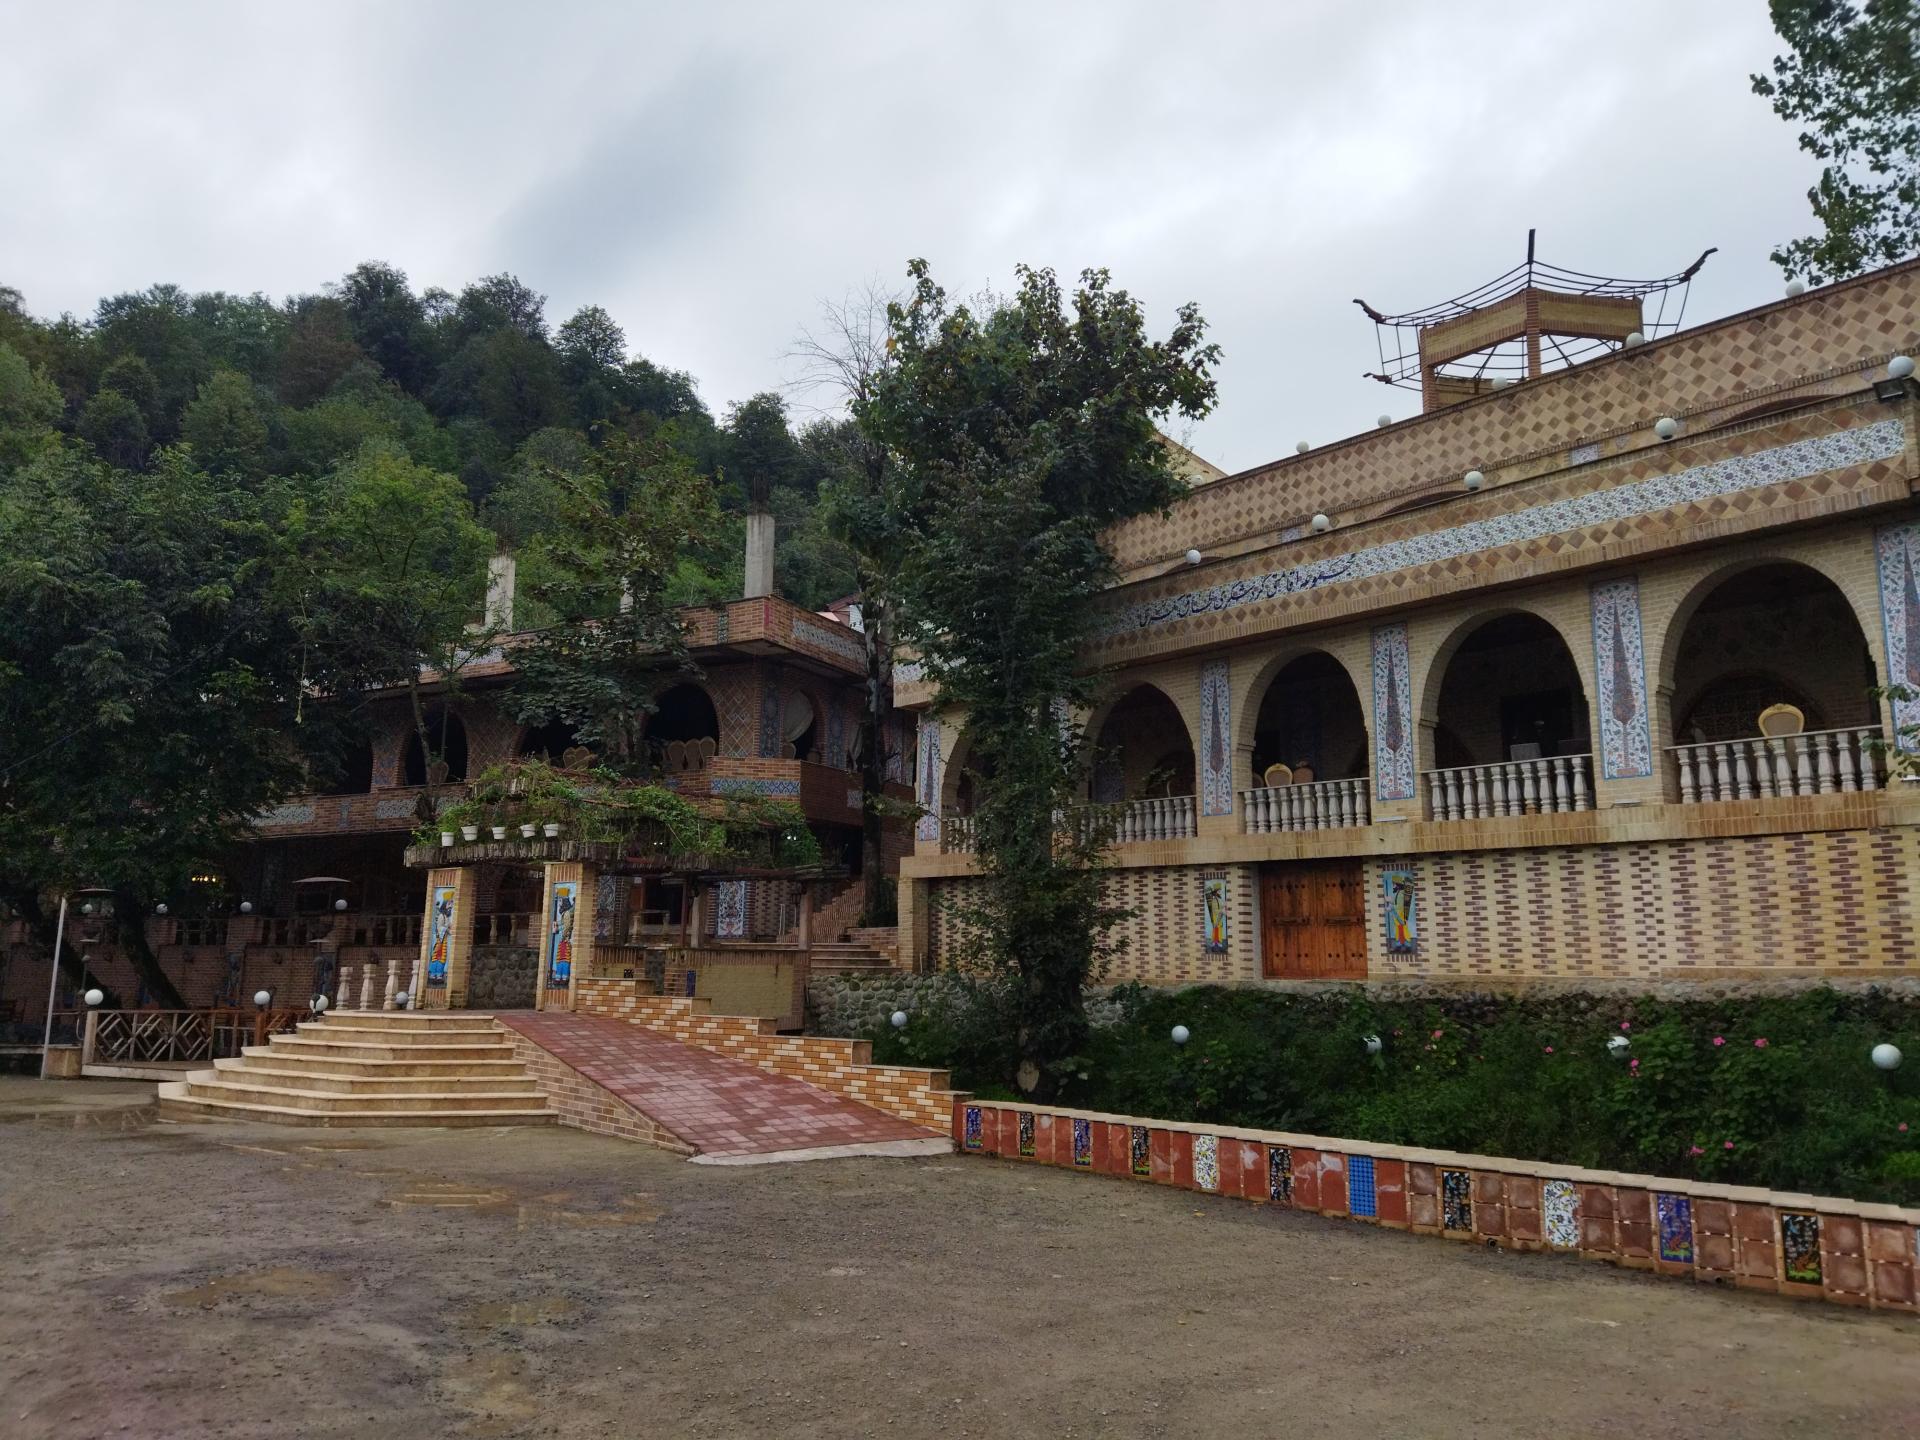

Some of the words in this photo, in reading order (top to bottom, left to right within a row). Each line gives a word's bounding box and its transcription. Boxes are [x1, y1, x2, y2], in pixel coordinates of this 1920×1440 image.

[1267, 571, 1299, 598] اقامتی
[1300, 552, 1356, 588] مجموعه
[1213, 574, 1272, 610] گردشگری
